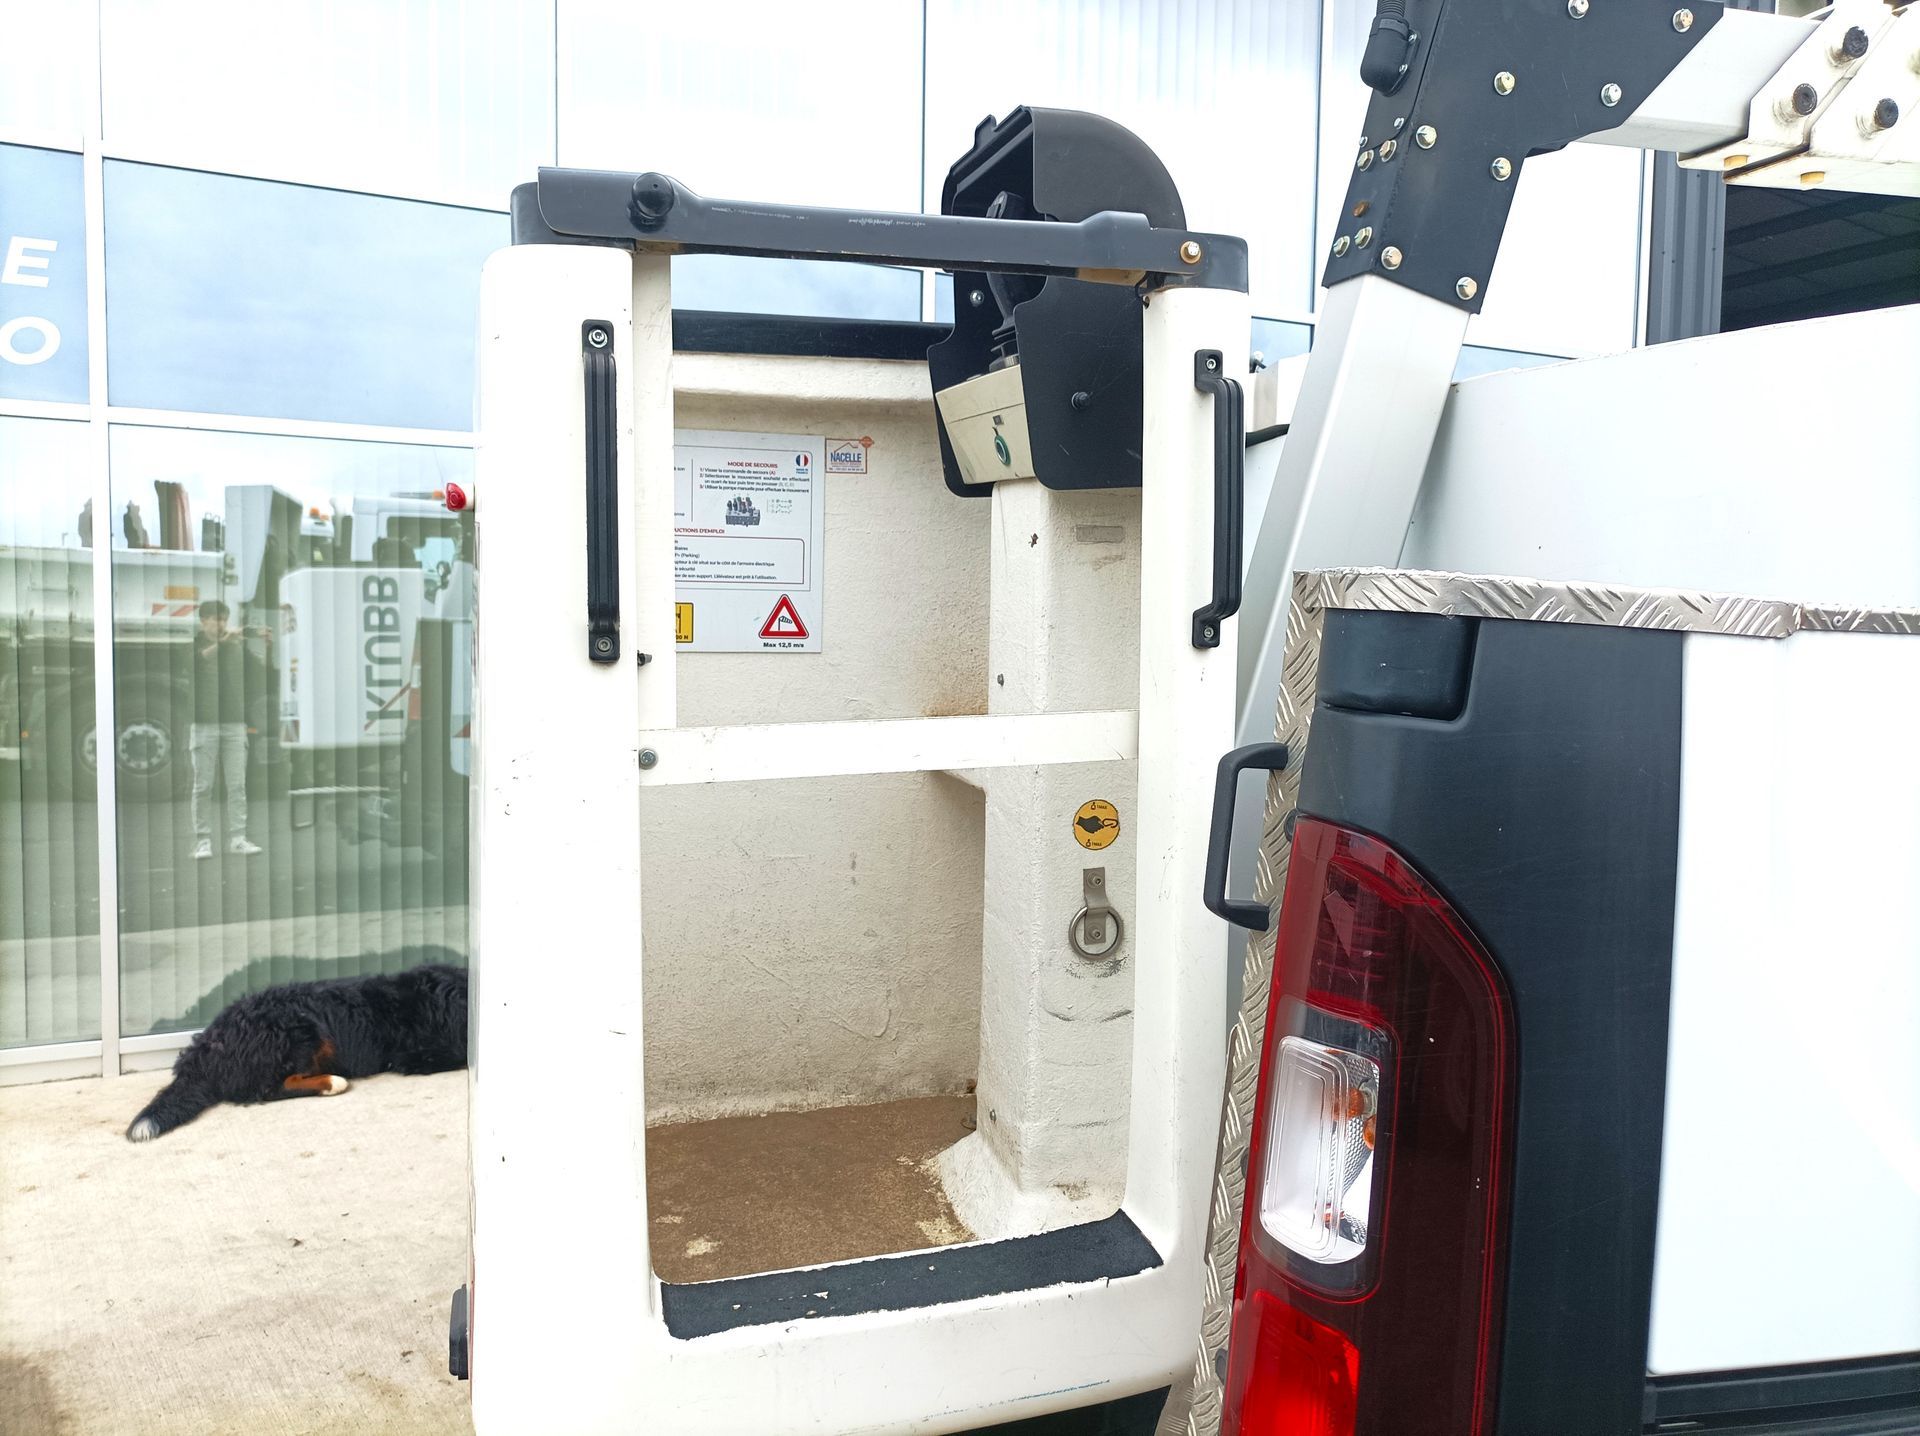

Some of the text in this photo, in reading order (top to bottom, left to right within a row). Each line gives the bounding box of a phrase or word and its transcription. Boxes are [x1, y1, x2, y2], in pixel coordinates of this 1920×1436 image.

[1, 235, 58, 288] E
[0, 315, 61, 365] O
[831, 452, 862, 462] NACELLE
